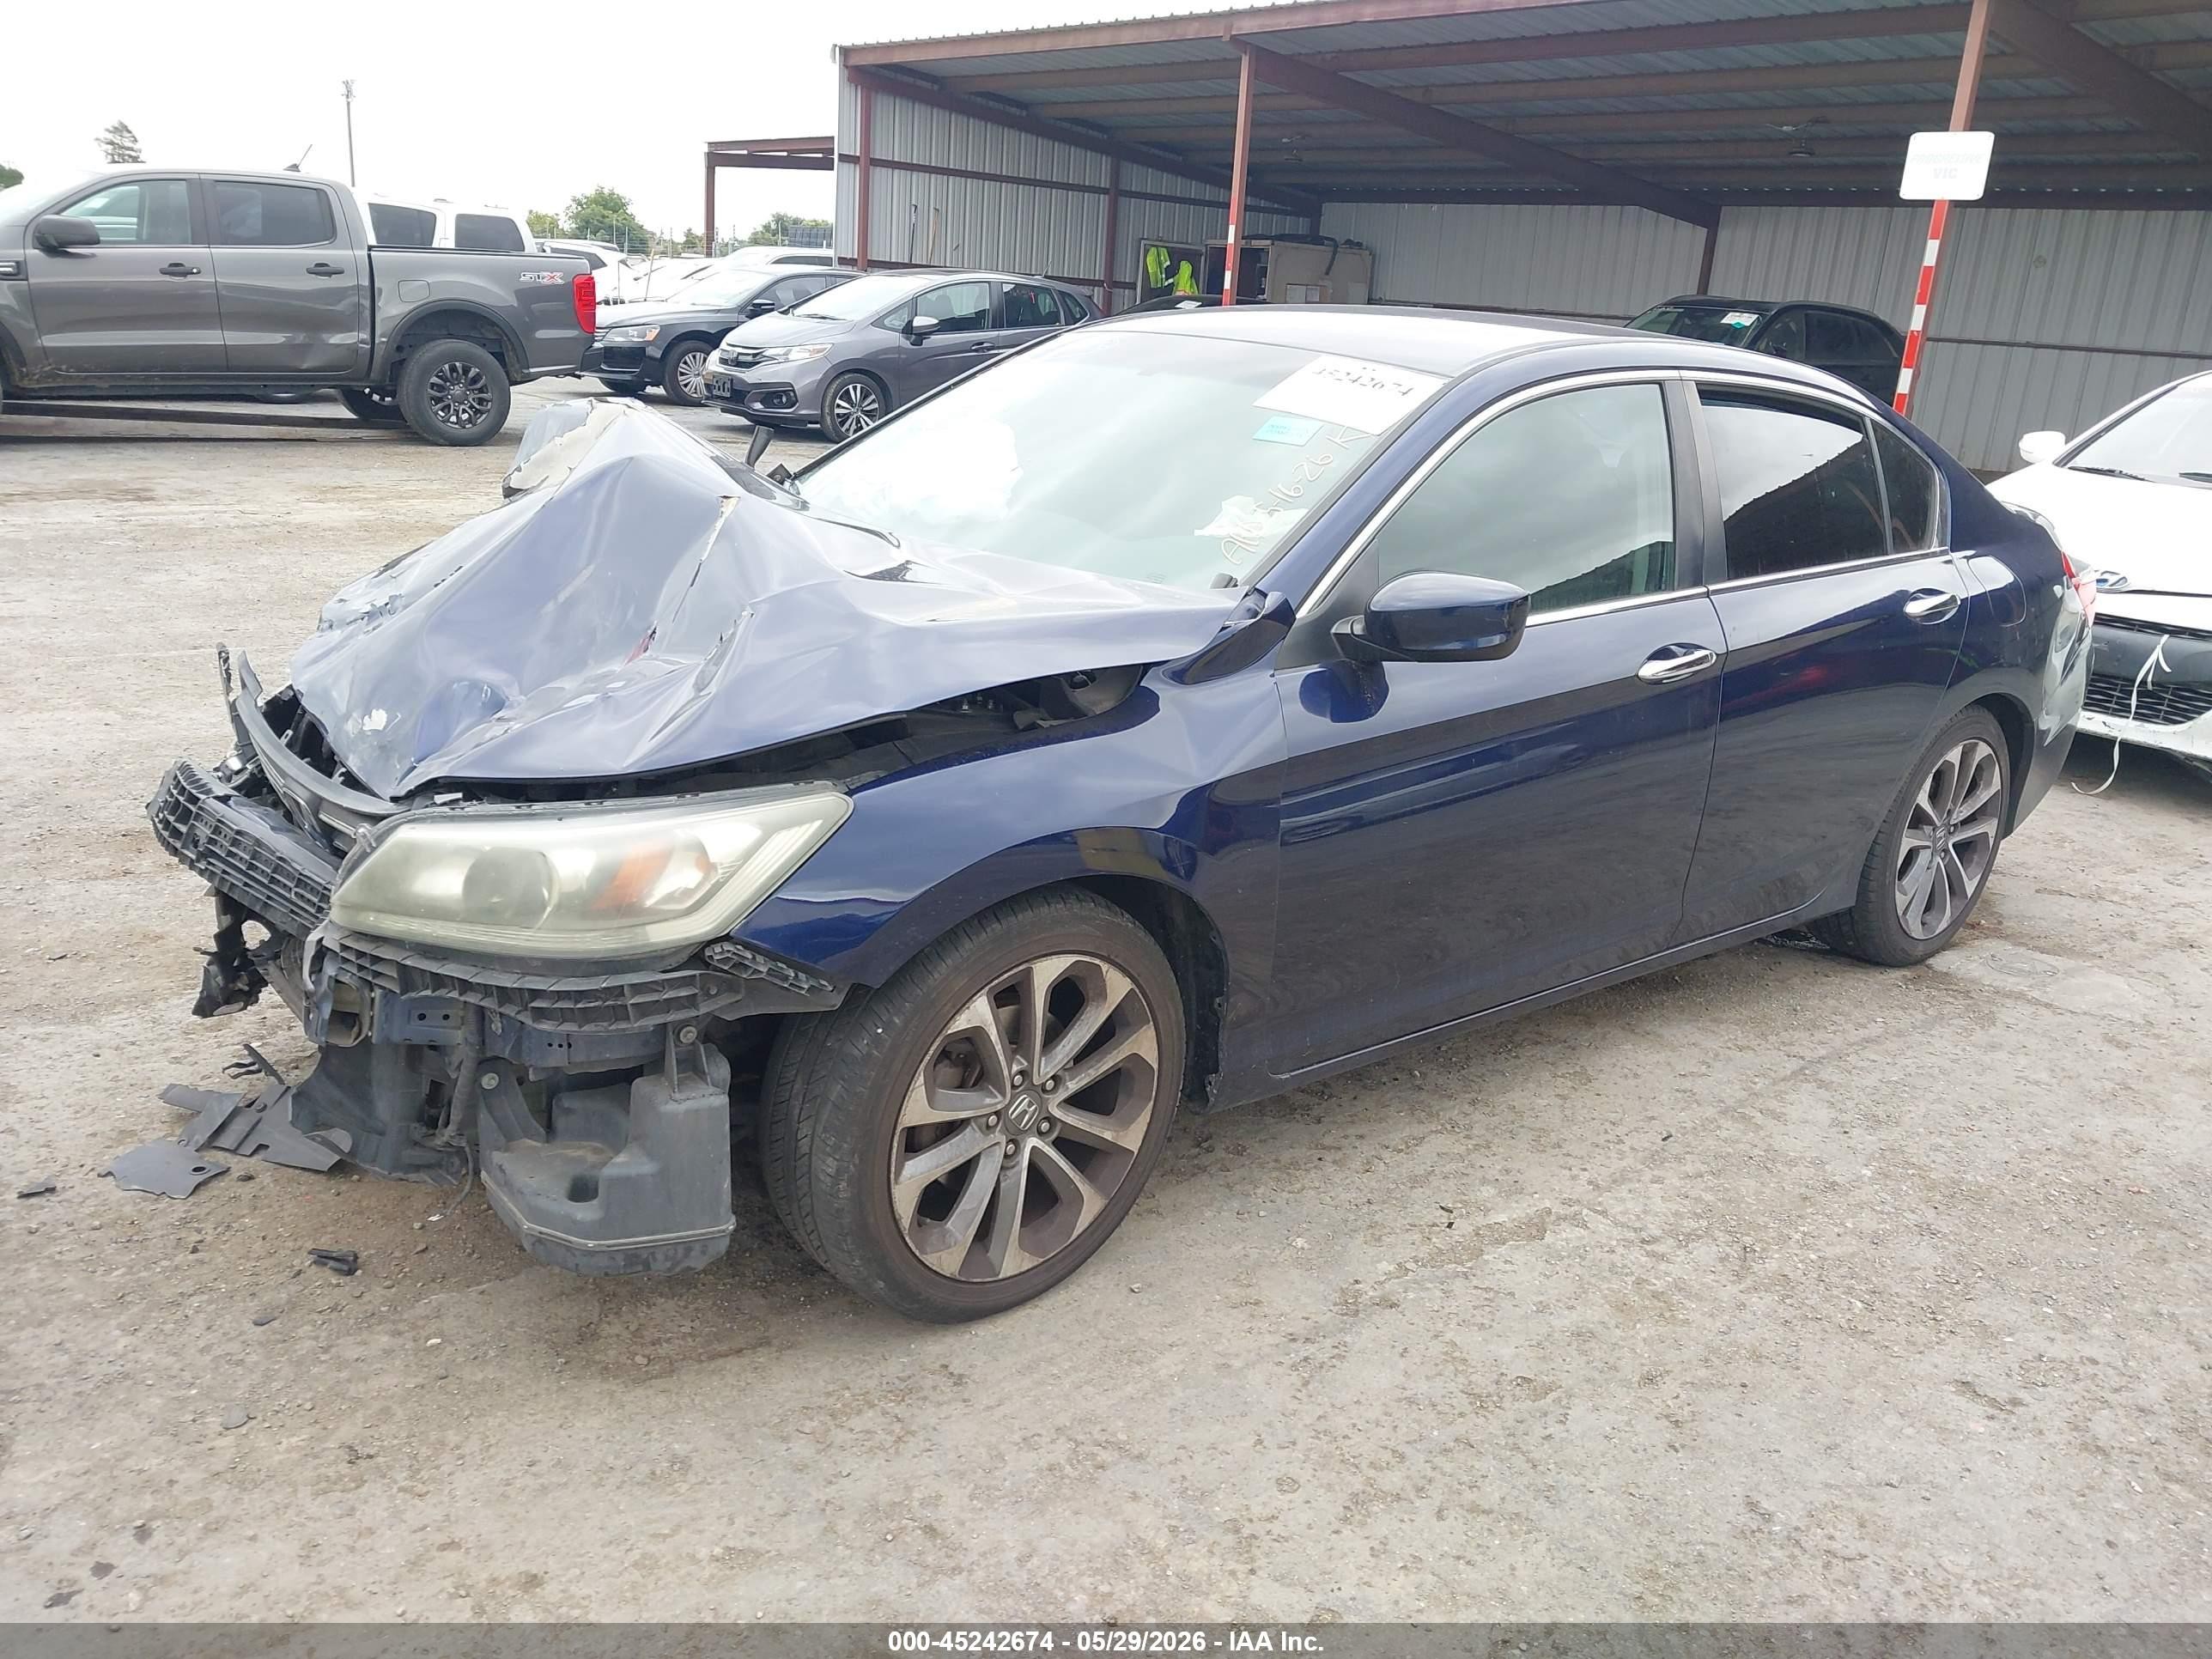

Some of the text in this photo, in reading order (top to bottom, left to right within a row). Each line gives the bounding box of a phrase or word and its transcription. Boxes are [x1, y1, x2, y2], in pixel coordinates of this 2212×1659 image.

[1933, 167, 1958, 179] VIC
[519, 270, 565, 284] STX
[1326, 424, 1371, 450] K
